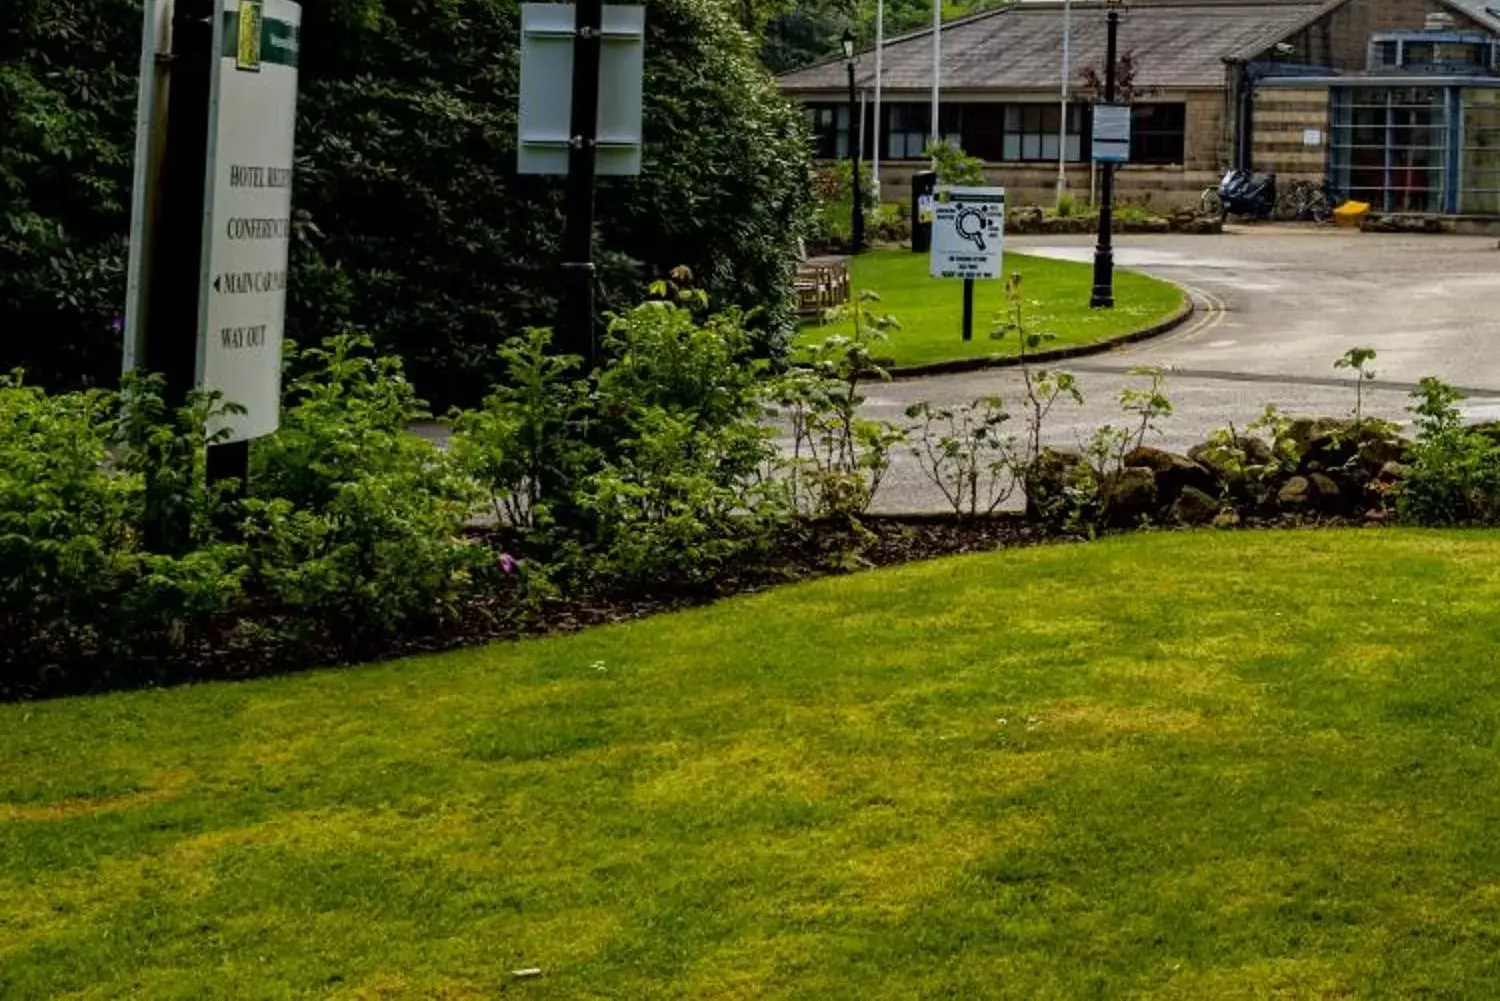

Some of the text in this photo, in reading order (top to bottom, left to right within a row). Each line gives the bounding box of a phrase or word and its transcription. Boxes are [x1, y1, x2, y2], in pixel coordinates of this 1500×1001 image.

[230, 165, 263, 188] HOTEL
[223, 272, 253, 294] MAIN
[221, 324, 267, 348] WAY OUT
